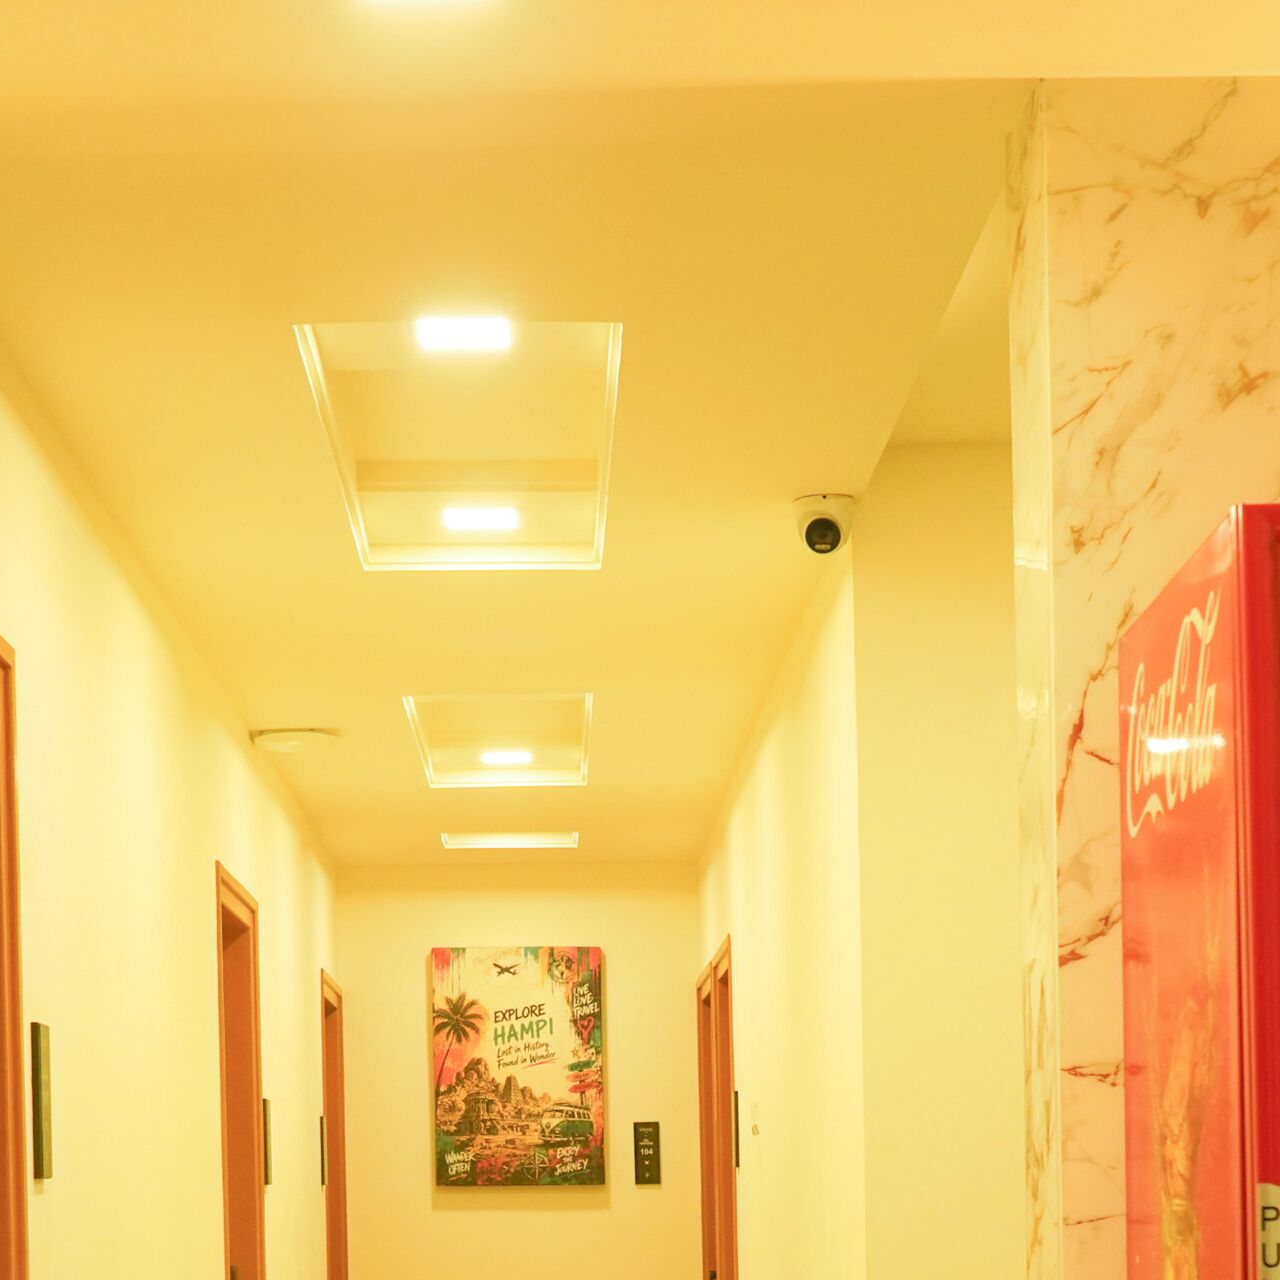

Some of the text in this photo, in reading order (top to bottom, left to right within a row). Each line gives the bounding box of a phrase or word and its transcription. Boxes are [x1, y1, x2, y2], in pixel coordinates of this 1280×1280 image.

[494, 1003, 546, 1024] EXPLORE
[493, 1017, 553, 1046] HAMPI
[497, 1046, 512, 1058] Lost
[523, 1041, 550, 1052] History
[497, 1056, 519, 1070] Found
[529, 1050, 556, 1063] Wonder
[640, 1148, 654, 1156] 104
